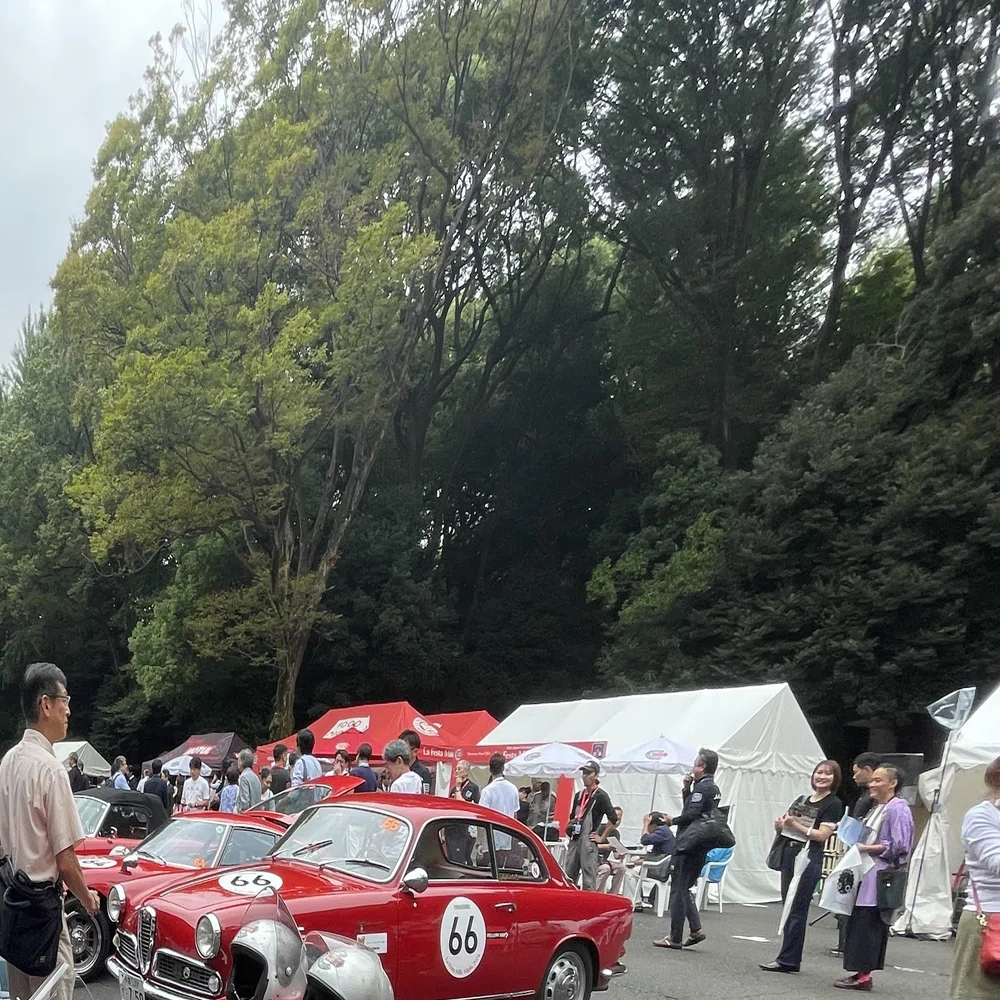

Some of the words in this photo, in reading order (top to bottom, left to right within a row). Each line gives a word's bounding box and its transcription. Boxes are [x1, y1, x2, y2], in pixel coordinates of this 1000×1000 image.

[423, 747, 430, 756] La
[230, 874, 271, 887] 66
[448, 915, 478, 955] 66
